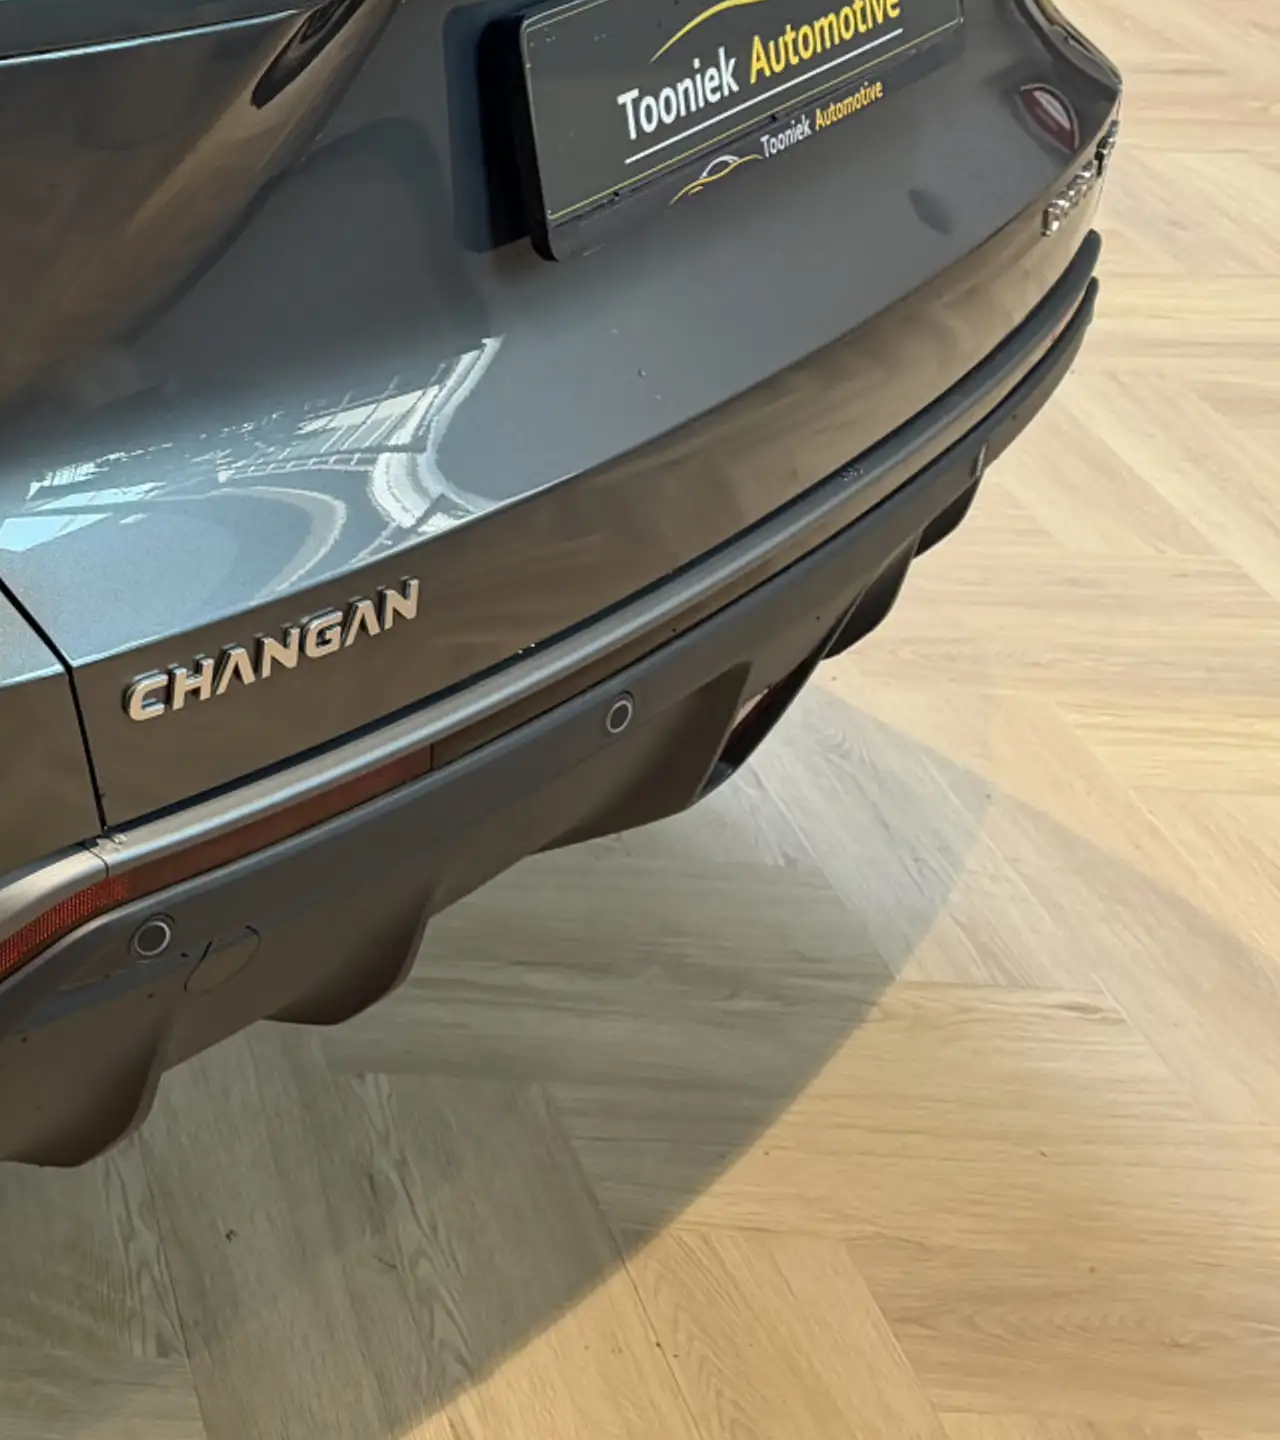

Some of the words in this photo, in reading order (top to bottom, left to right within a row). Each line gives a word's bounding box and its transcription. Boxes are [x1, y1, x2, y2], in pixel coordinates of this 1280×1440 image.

[616, 46, 740, 140] Tooniek
[760, 114, 813, 158] Tooniek
[814, 79, 884, 131] Automotive
[124, 575, 420, 721] CHANGAN
